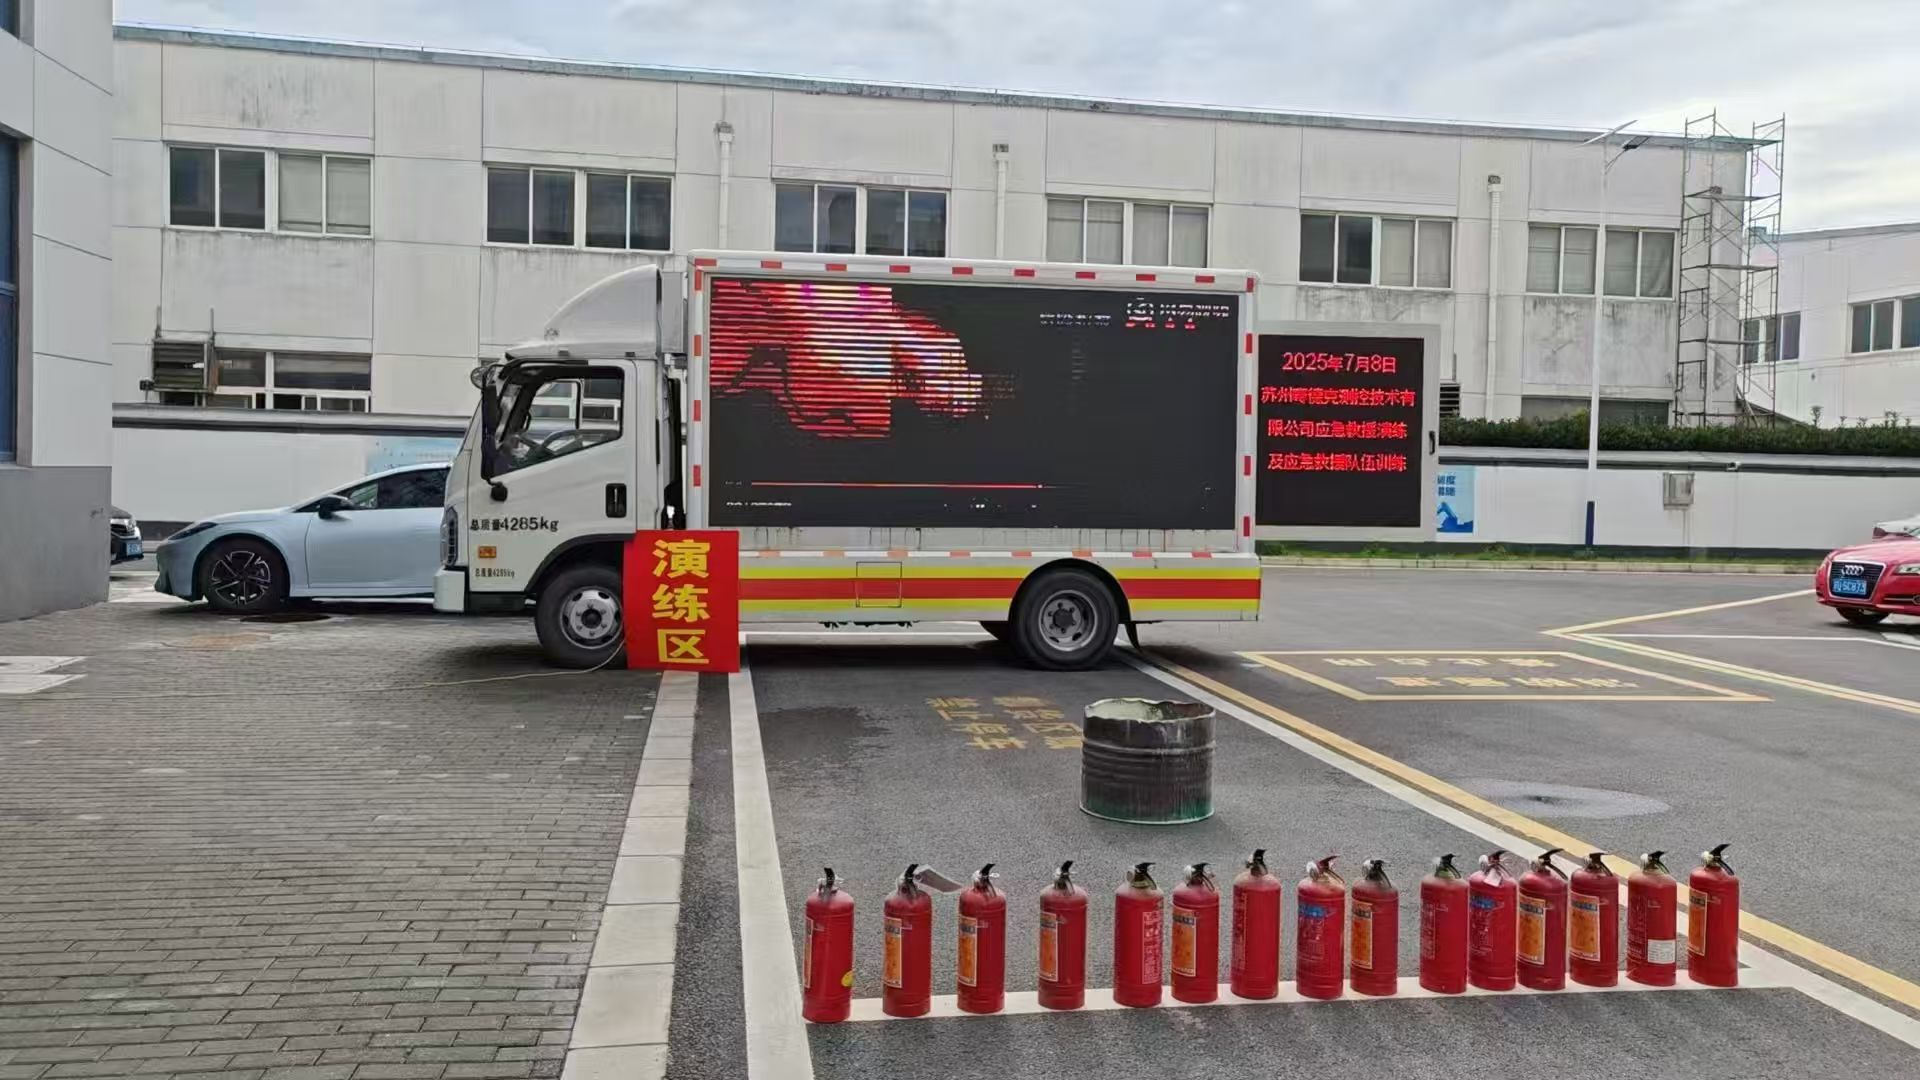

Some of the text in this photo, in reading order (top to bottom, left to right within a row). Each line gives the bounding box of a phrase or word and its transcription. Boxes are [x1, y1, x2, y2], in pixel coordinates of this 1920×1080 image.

[1282, 352, 1396, 373] 2025年7月8日
[1268, 419, 1408, 439] 限公司应急救援演练
[1267, 452, 1407, 472] 及应急救援队伍训练
[470, 516, 559, 532] 总质量4285kg
[652, 539, 711, 664] 演练区
